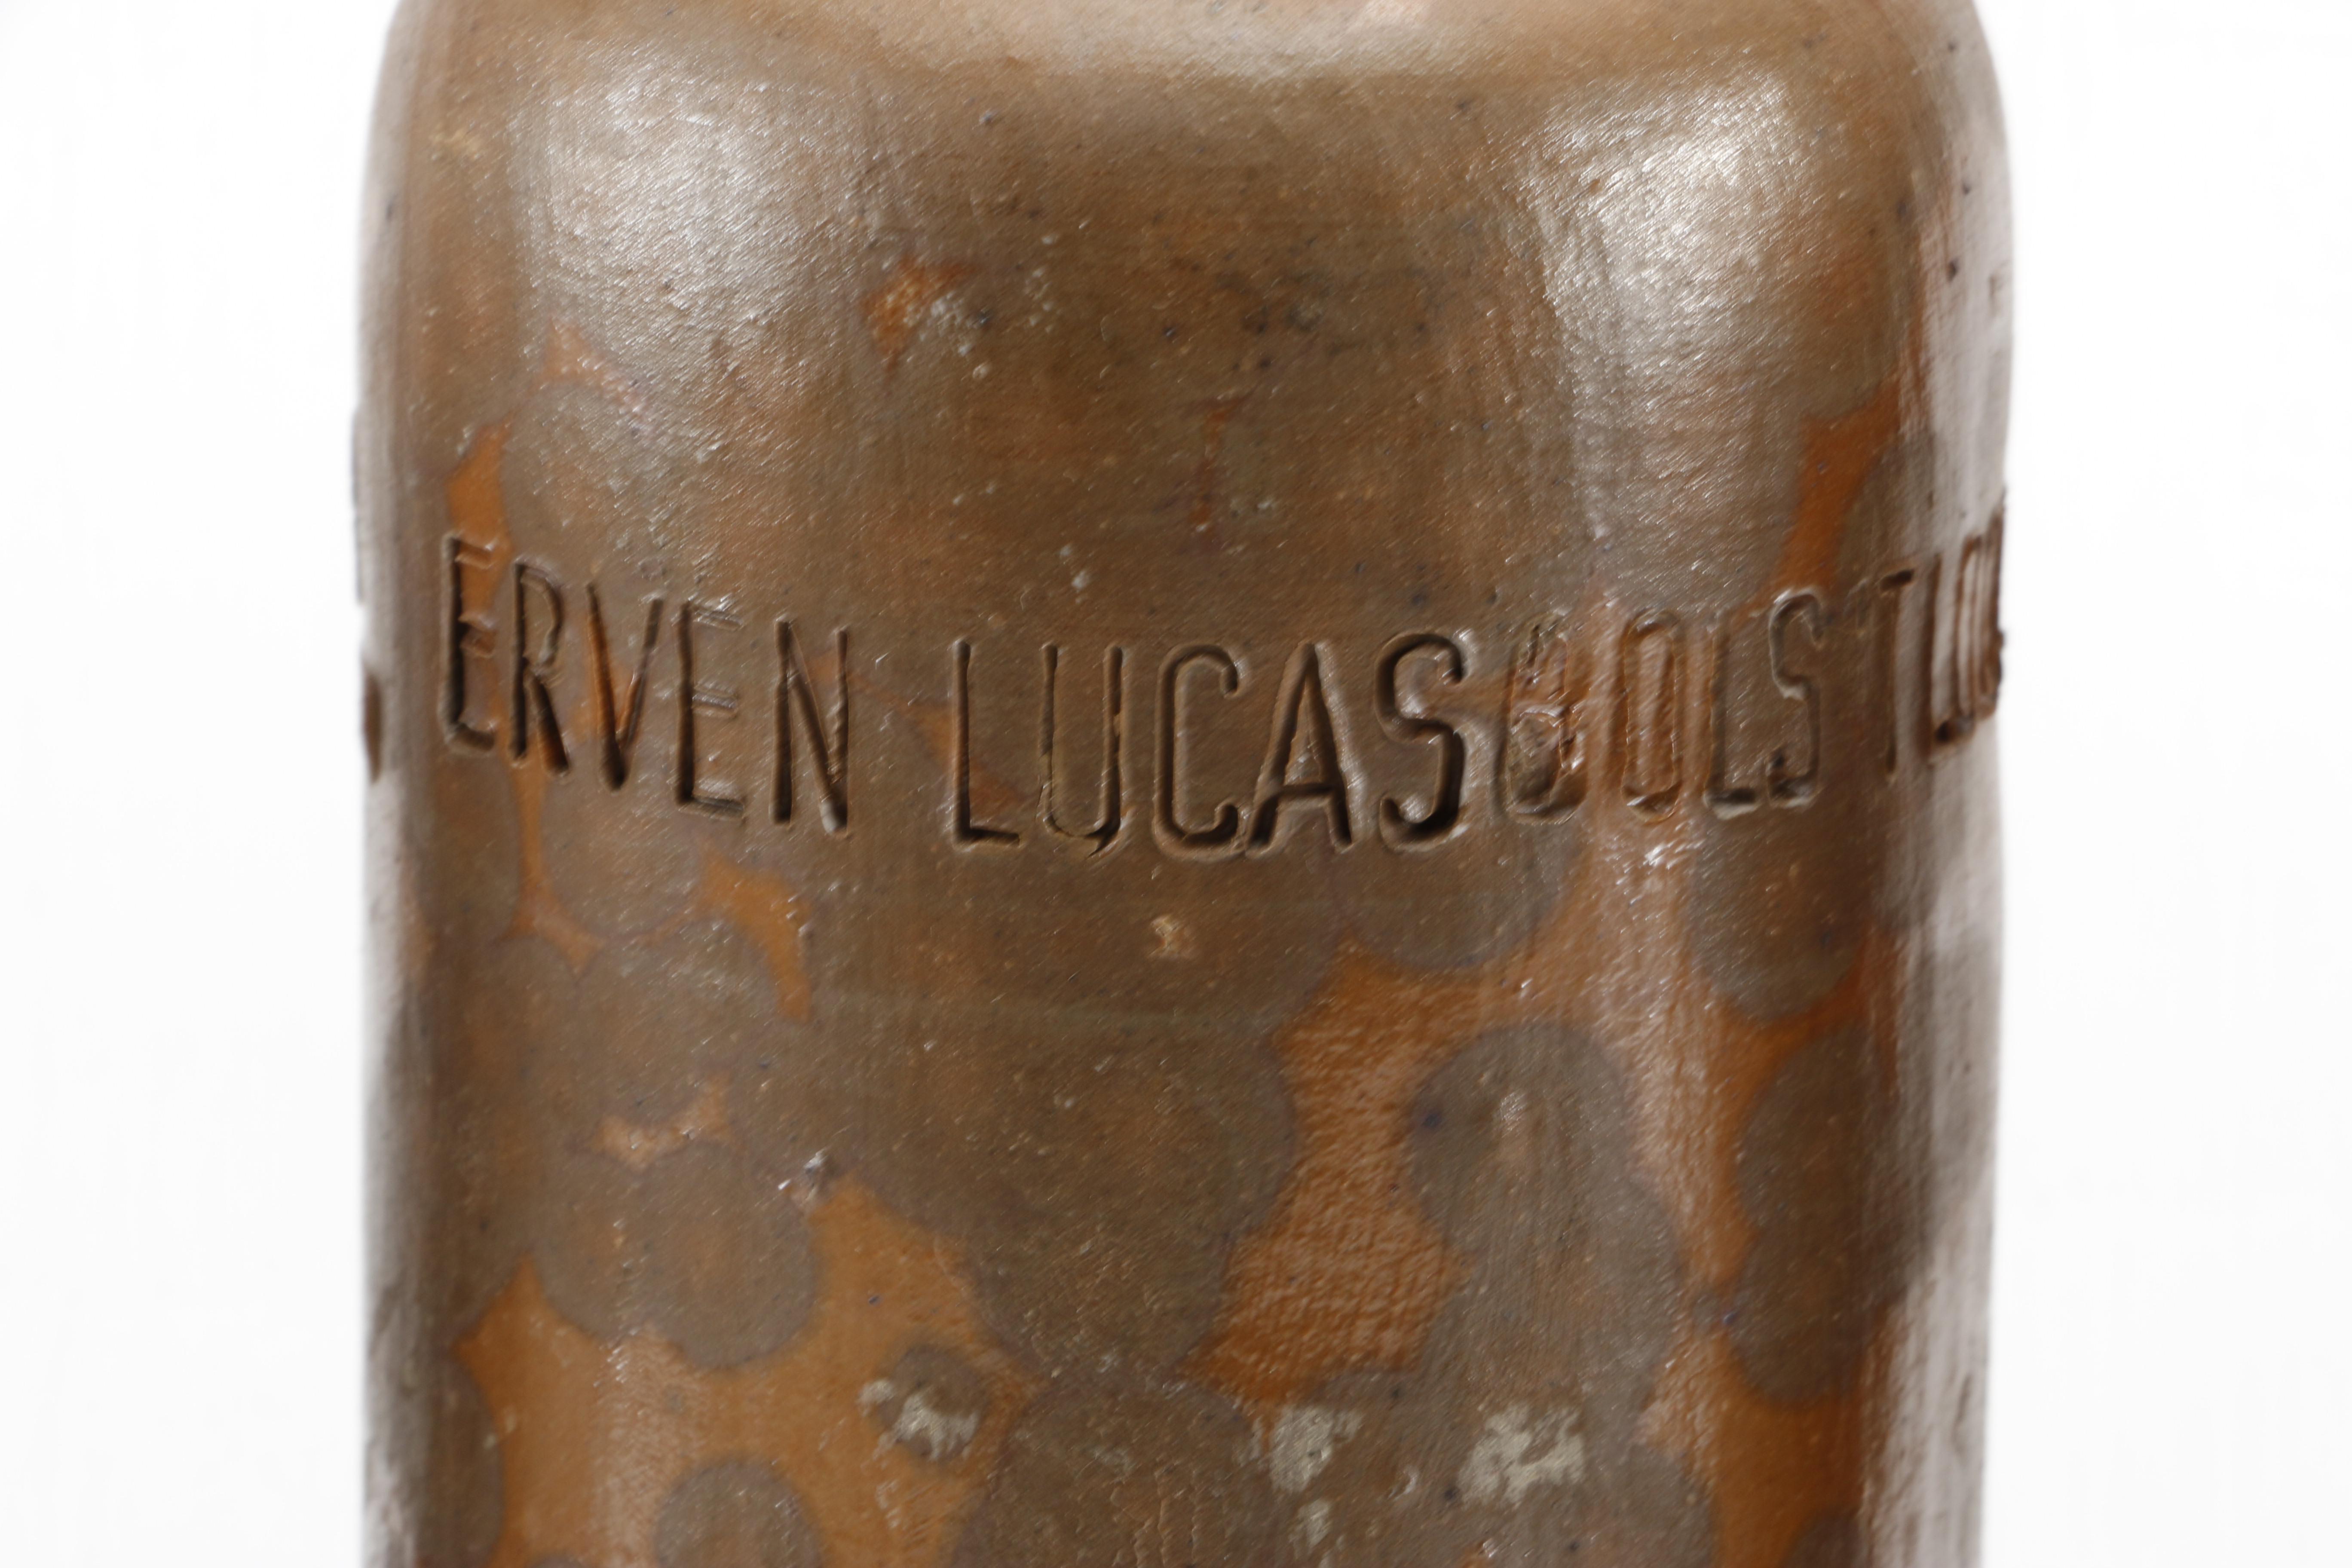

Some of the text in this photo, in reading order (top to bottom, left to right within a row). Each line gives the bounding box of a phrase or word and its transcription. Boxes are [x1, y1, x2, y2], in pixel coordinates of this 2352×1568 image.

[441, 532, 851, 835] ERVEN
[951, 628, 1470, 861] LUCAS
[1500, 587, 1822, 826] BOLS
